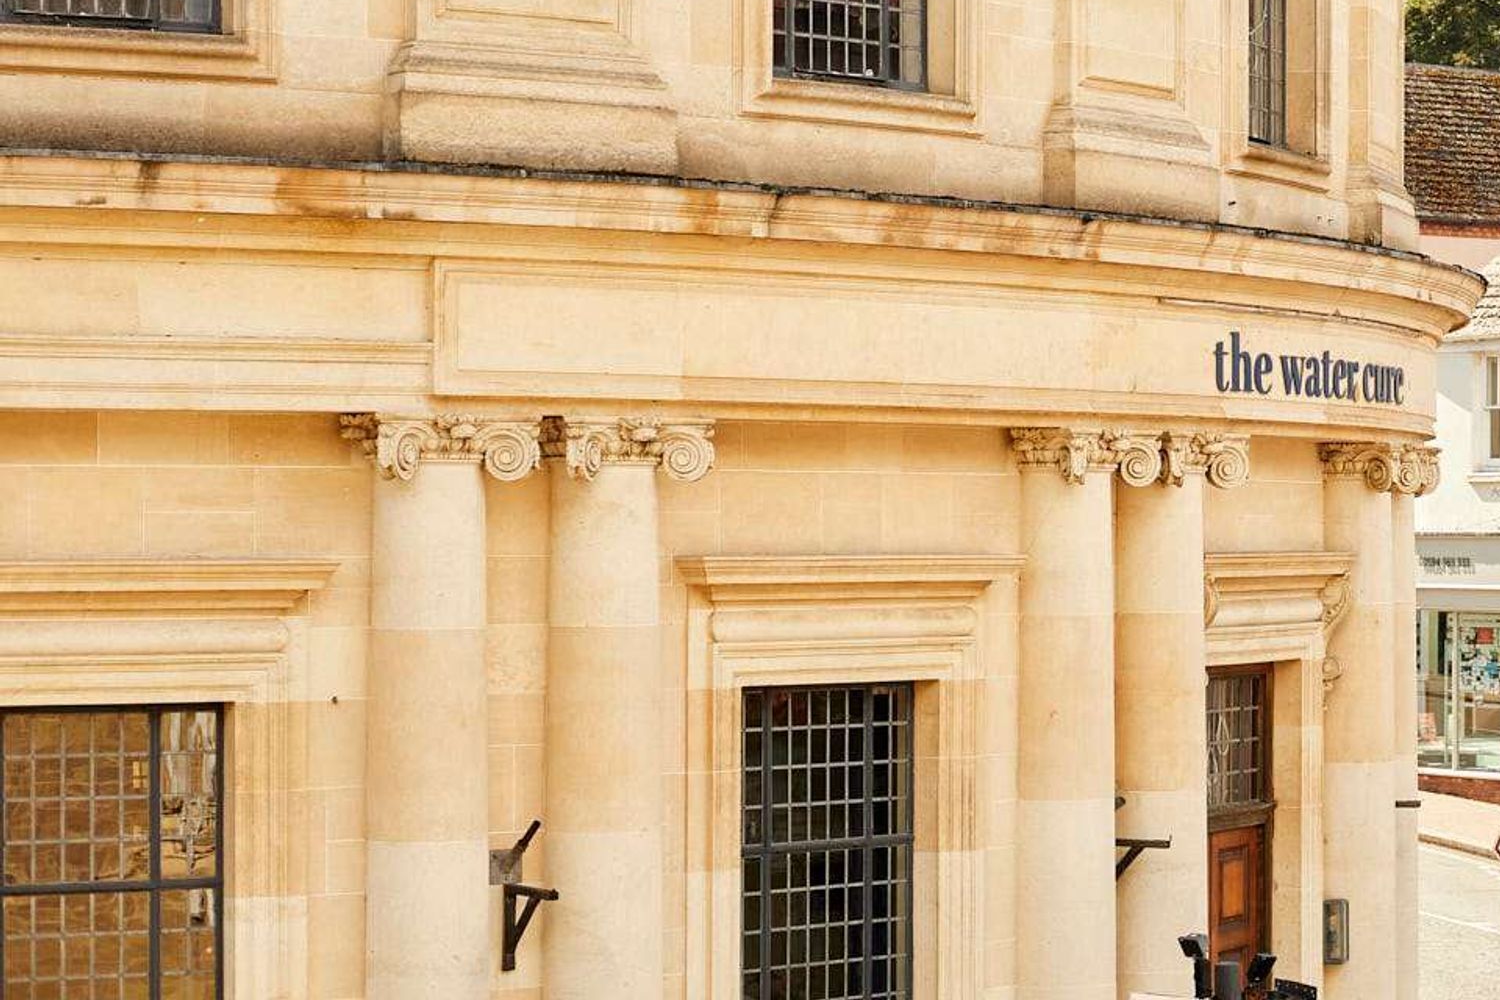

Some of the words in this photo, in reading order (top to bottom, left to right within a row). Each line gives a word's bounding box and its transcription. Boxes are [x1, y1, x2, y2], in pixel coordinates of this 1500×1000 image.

[1213, 331, 1273, 395] the
[1280, 350, 1359, 403] water
[1362, 363, 1405, 405] cure
